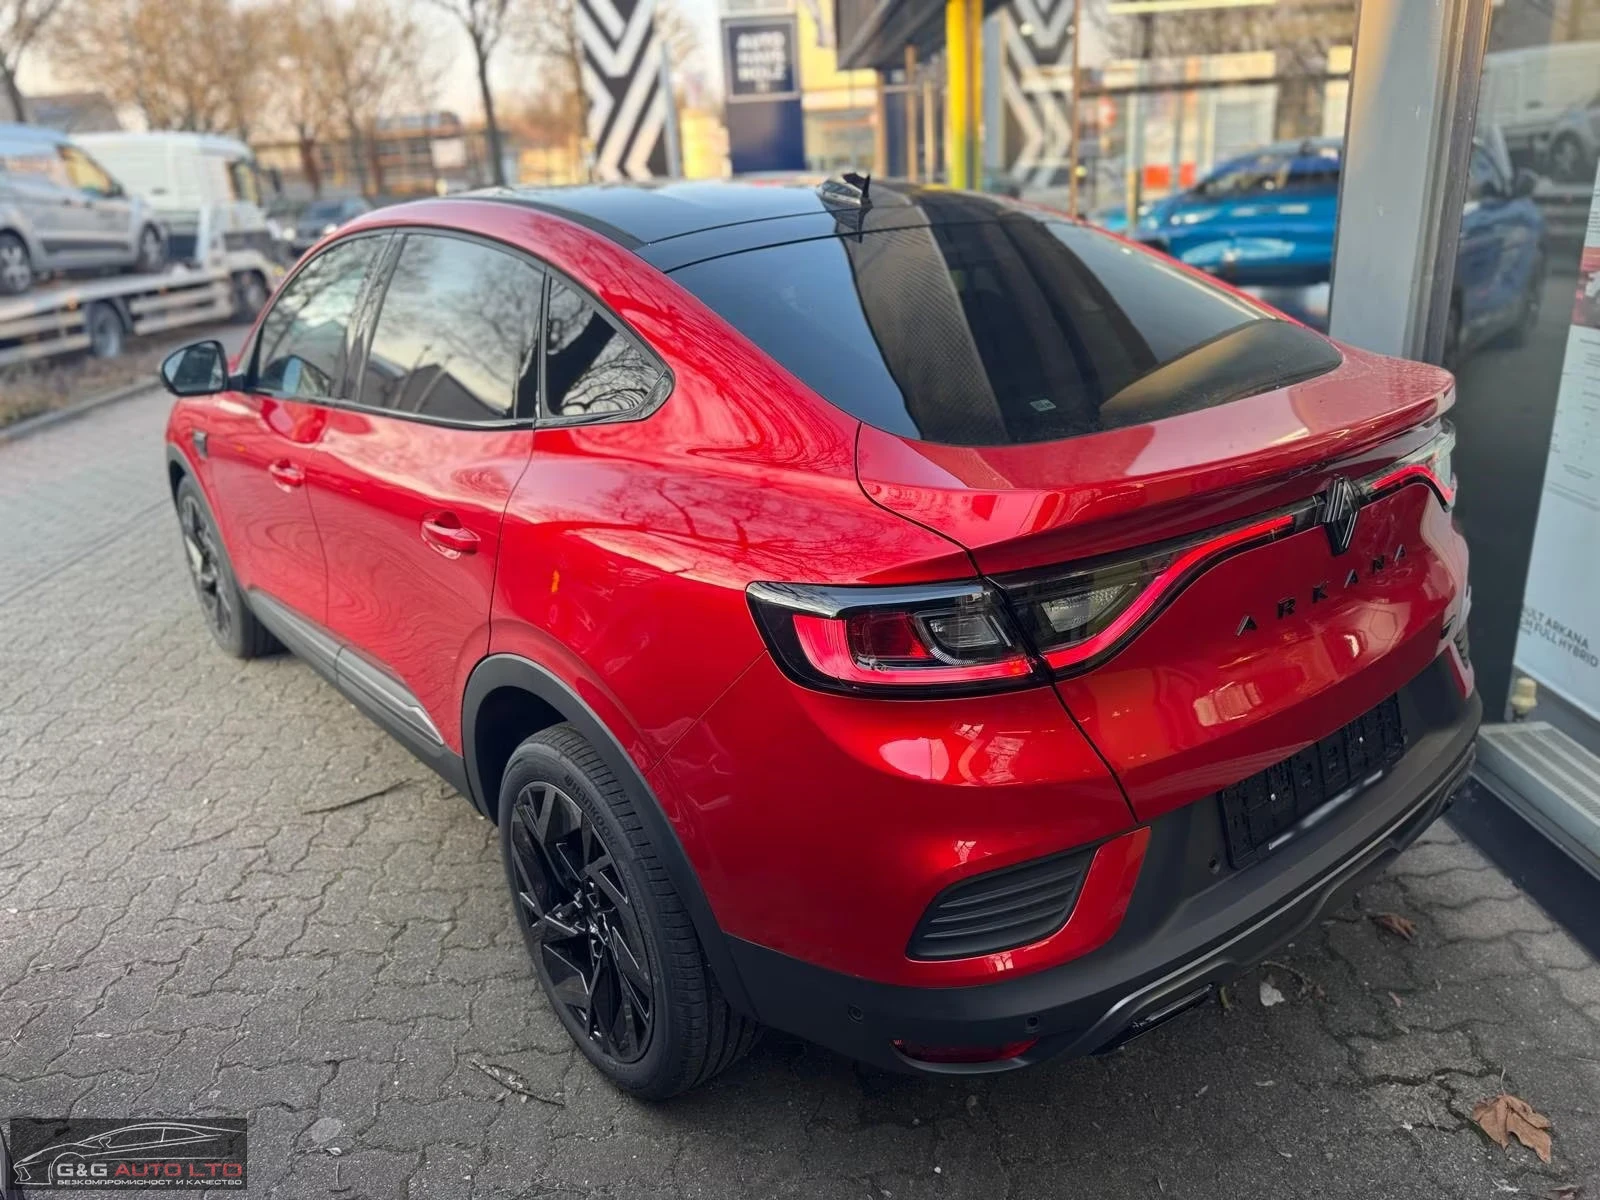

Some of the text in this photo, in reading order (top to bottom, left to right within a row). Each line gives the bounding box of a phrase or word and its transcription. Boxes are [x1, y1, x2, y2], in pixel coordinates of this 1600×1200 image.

[1237, 544, 1406, 637] ARKANA
[1544, 616, 1589, 650] ARKANA
[1558, 637, 1599, 668] HYBRID
